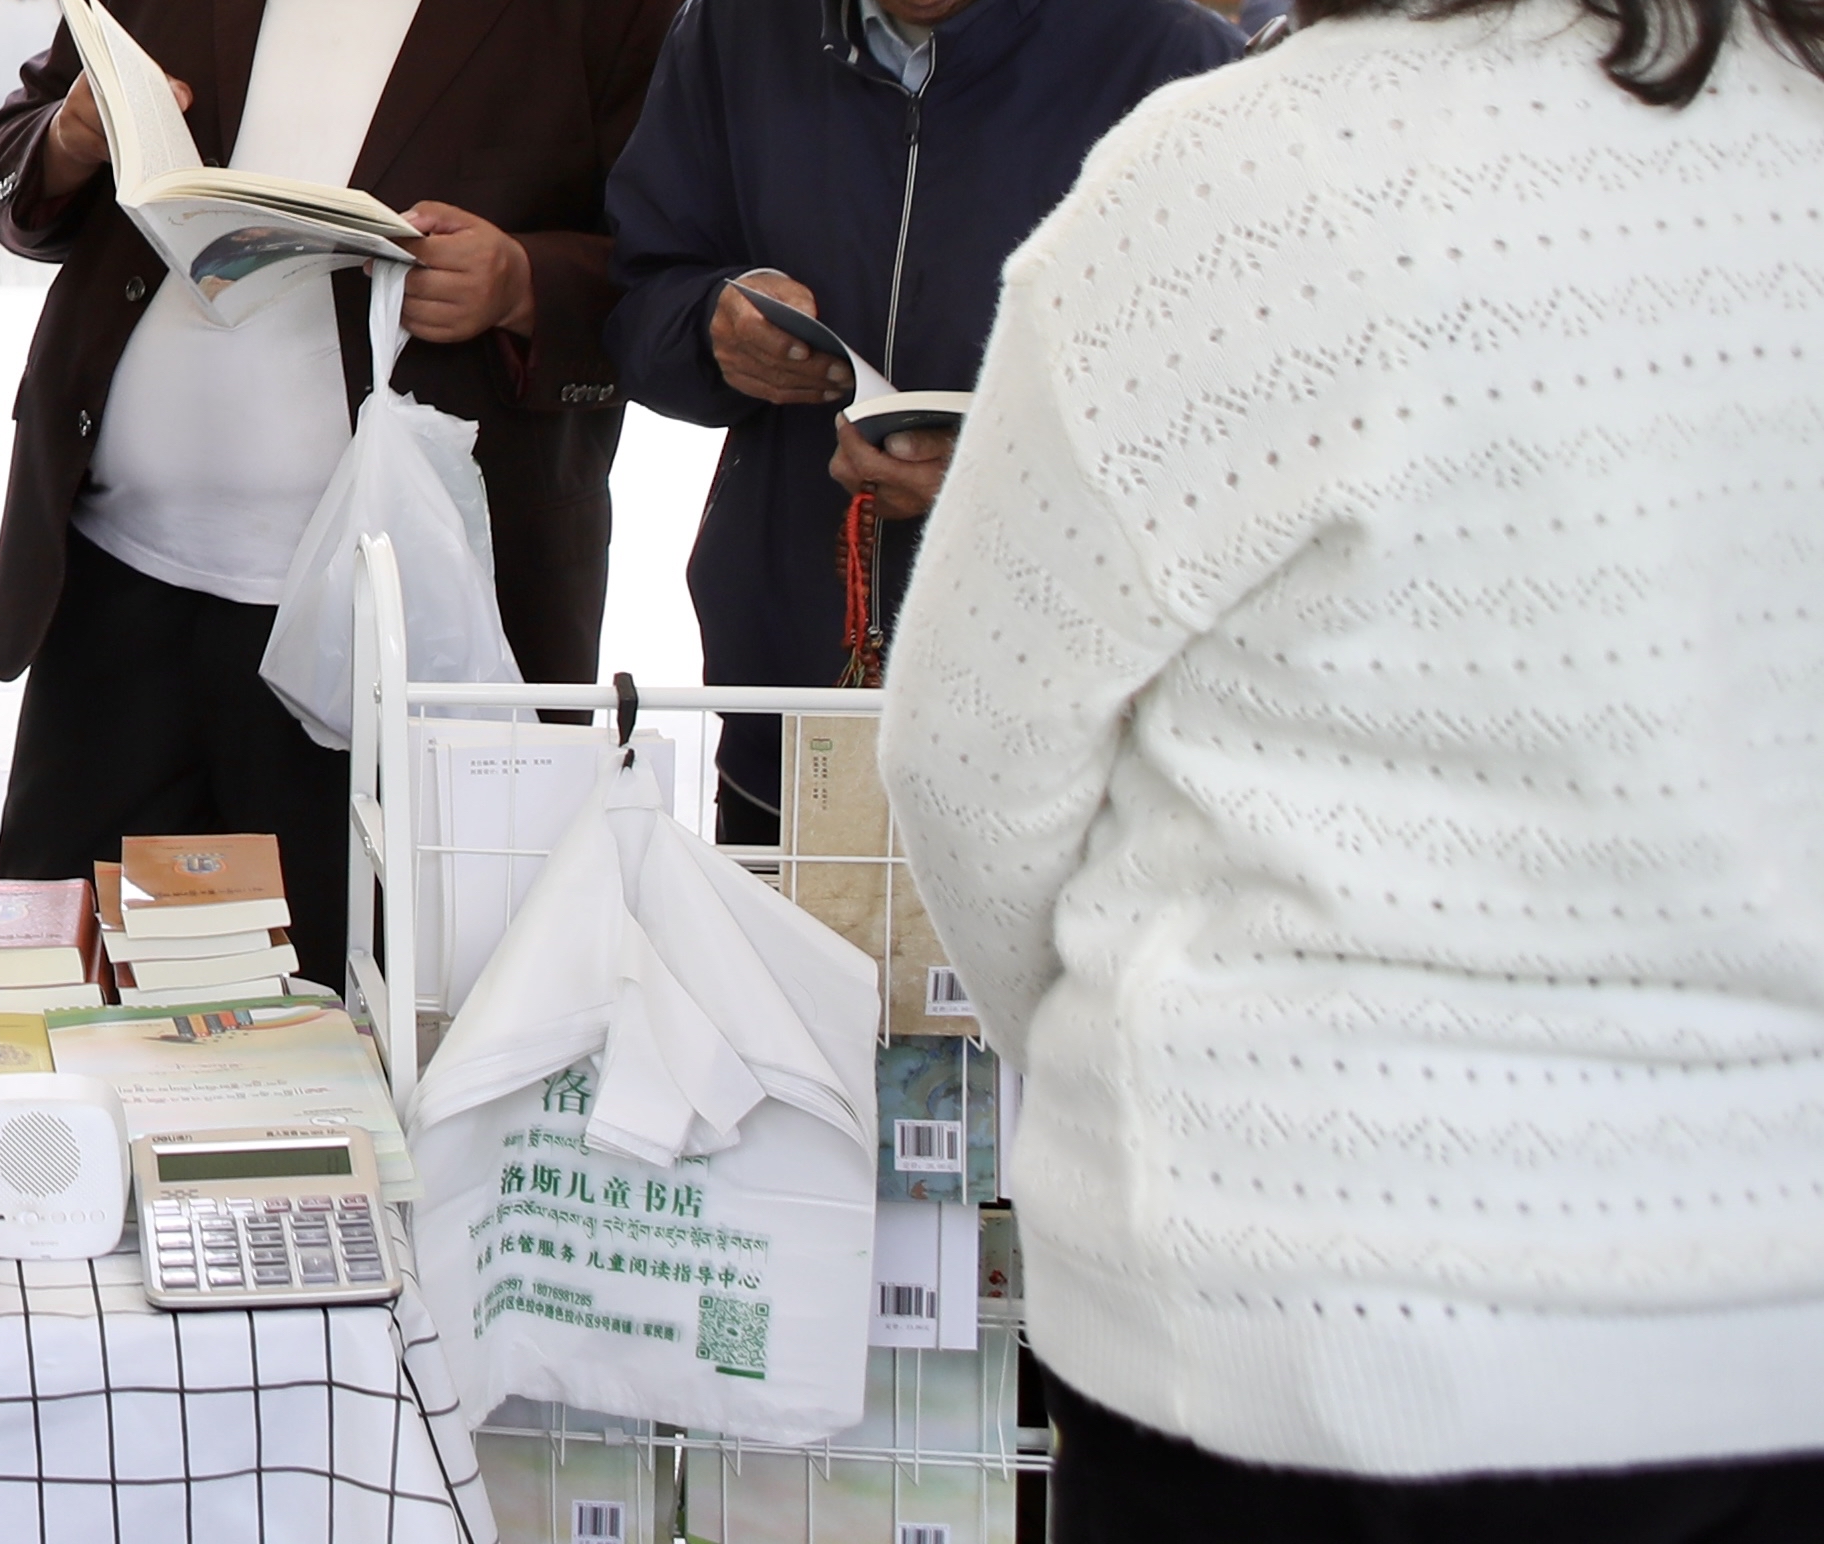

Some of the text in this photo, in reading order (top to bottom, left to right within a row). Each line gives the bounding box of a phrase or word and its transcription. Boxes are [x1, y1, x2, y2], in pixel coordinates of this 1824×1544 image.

[501, 1164, 704, 1219] 洛斯儿童书店
[499, 1233, 576, 1263] 托管服务
[585, 1250, 762, 1290] 儿童阅读指导中心
